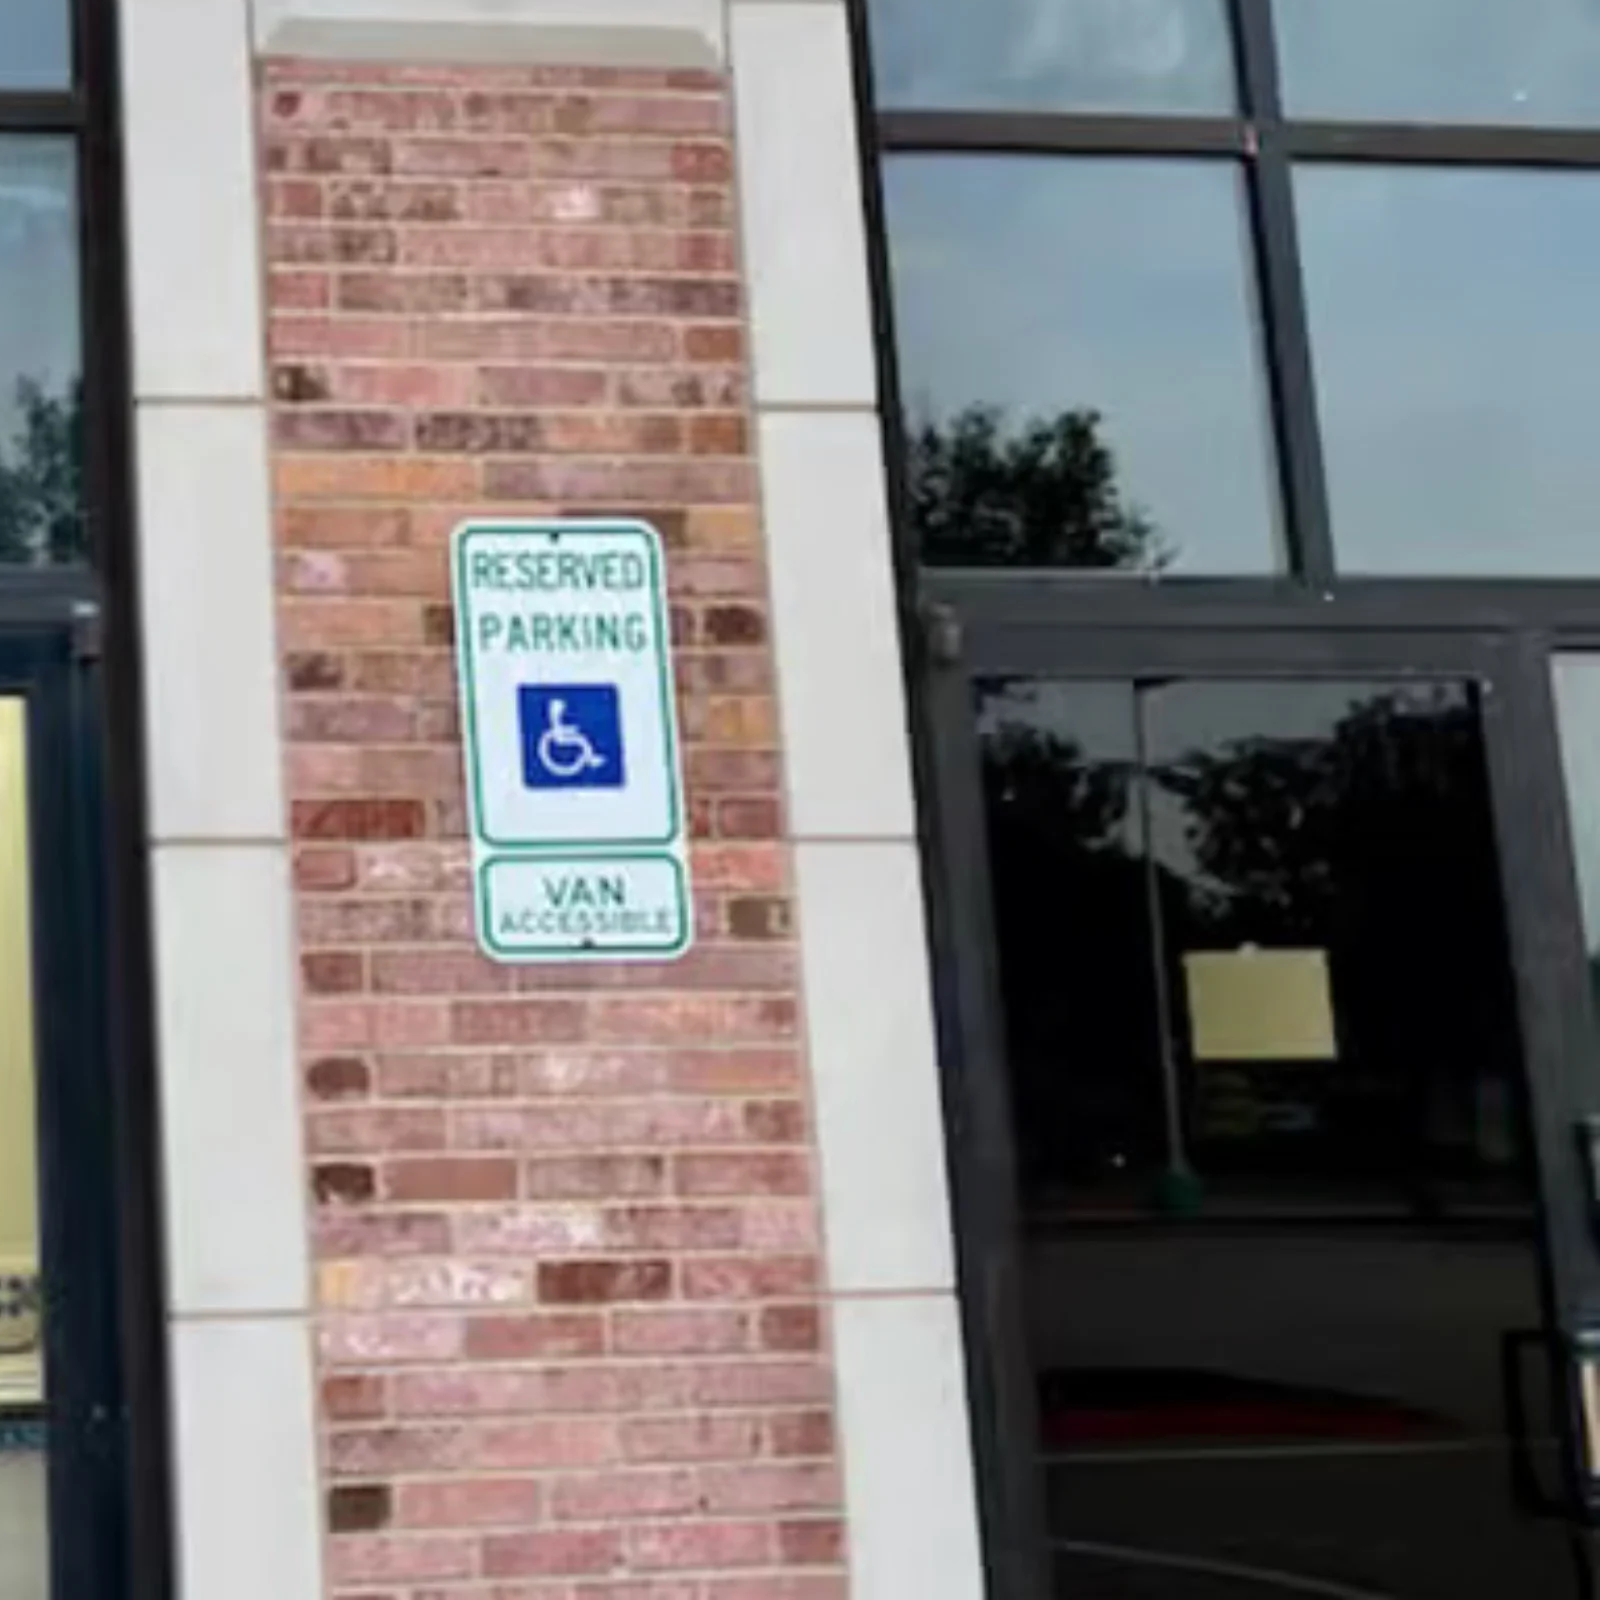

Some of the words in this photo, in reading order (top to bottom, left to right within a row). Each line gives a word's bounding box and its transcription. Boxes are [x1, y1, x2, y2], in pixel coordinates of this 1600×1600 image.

[471, 550, 646, 590] RESERVED
[478, 612, 649, 651] PARKING
[542, 874, 628, 907] VAN
[498, 908, 675, 936] ACCESSIBLE
